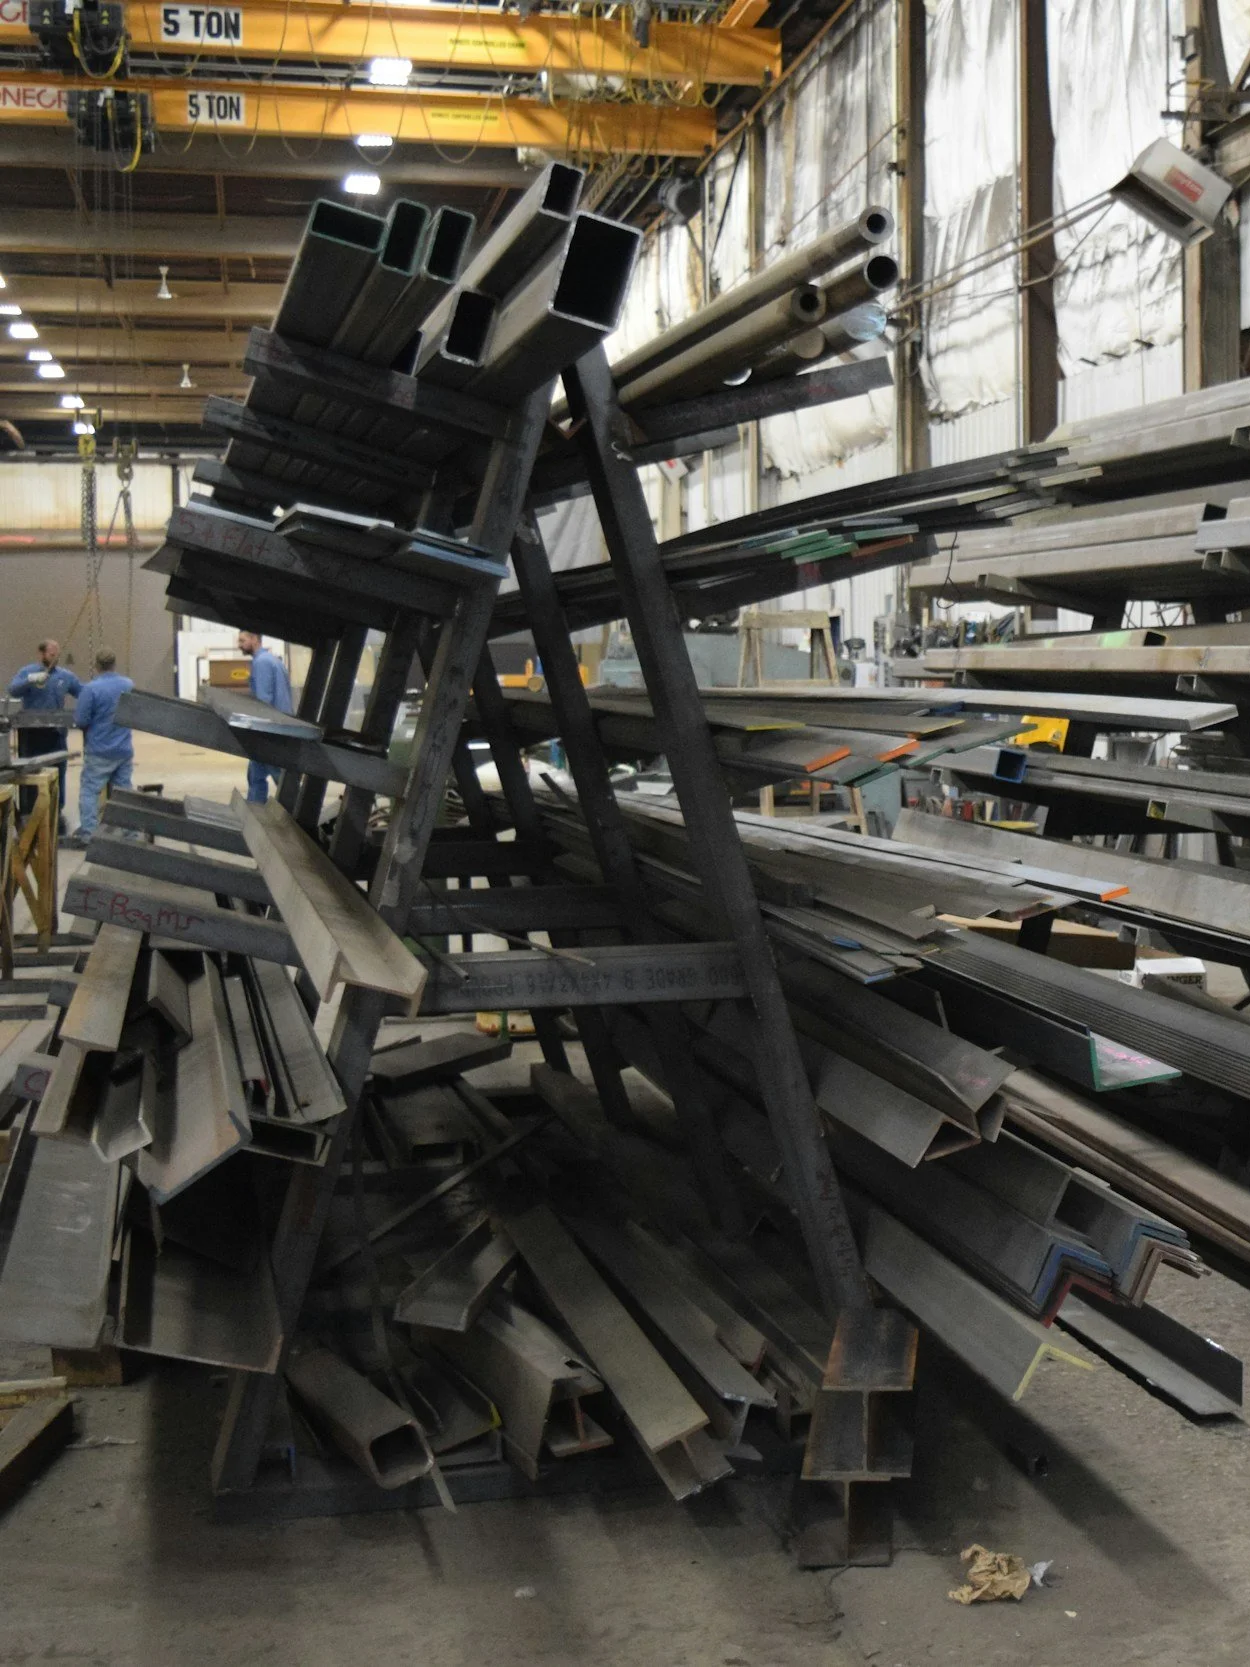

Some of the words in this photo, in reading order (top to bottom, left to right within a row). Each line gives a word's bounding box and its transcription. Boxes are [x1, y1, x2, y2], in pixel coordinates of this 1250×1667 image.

[163, 9, 180, 37] 5
[189, 10, 241, 39] TON
[188, 94, 200, 119] 5
[205, 95, 241, 120] TON
